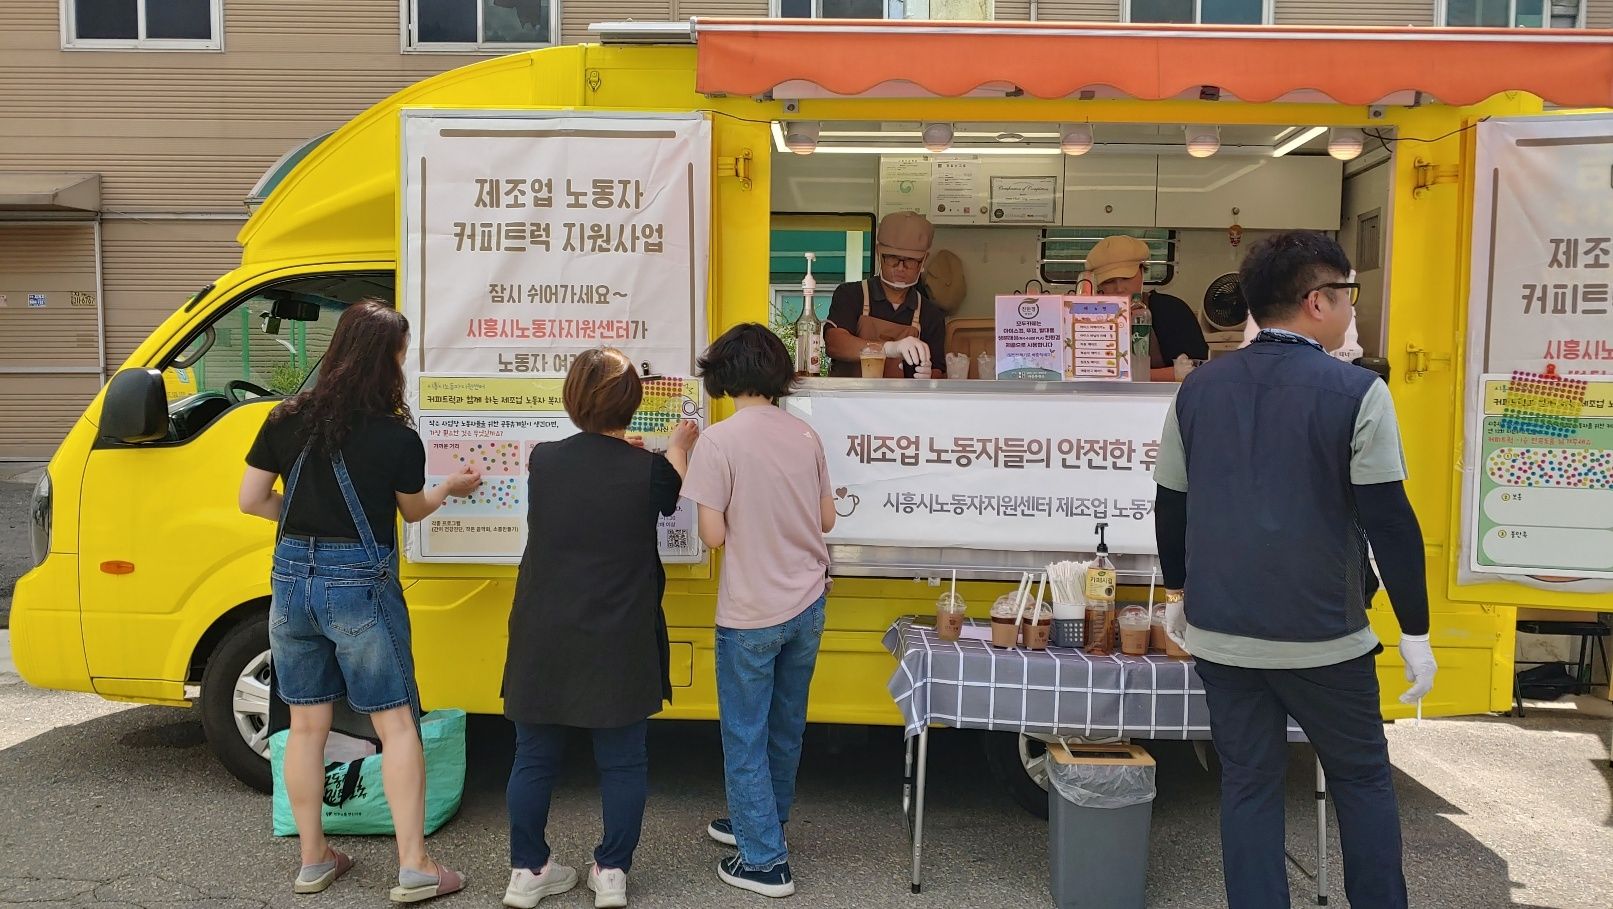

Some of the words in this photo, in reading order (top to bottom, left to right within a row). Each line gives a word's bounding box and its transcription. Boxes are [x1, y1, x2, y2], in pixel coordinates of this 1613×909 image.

[474, 177, 553, 209] 제조업
[566, 178, 644, 210] 노동자
[453, 221, 551, 252] 커피트럭
[562, 222, 664, 253] 지원사업
[1548, 236, 1613, 269] 제조
[488, 283, 522, 304] 잠시
[527, 284, 628, 305] 쉬어가세요~
[1521, 283, 1613, 314] 커피트
[466, 318, 648, 340] 시흥시노동자지원센터가
[498, 353, 548, 373] 노동자
[427, 395, 463, 406] 커피트럭과
[466, 395, 482, 405] 함께
[485, 395, 499, 405] 하는
[501, 395, 523, 405] 제조업
[525, 396, 546, 405] 노동자
[441, 420, 459, 428] 사업장
[487, 420, 499, 428] 위한
[846, 434, 919, 467] 제조업
[926, 435, 1051, 469] 노동자들의
[1057, 438, 1136, 471] 안전한
[883, 491, 1052, 518] 시흥시노동자지원센터
[1056, 495, 1109, 520] 제조업
